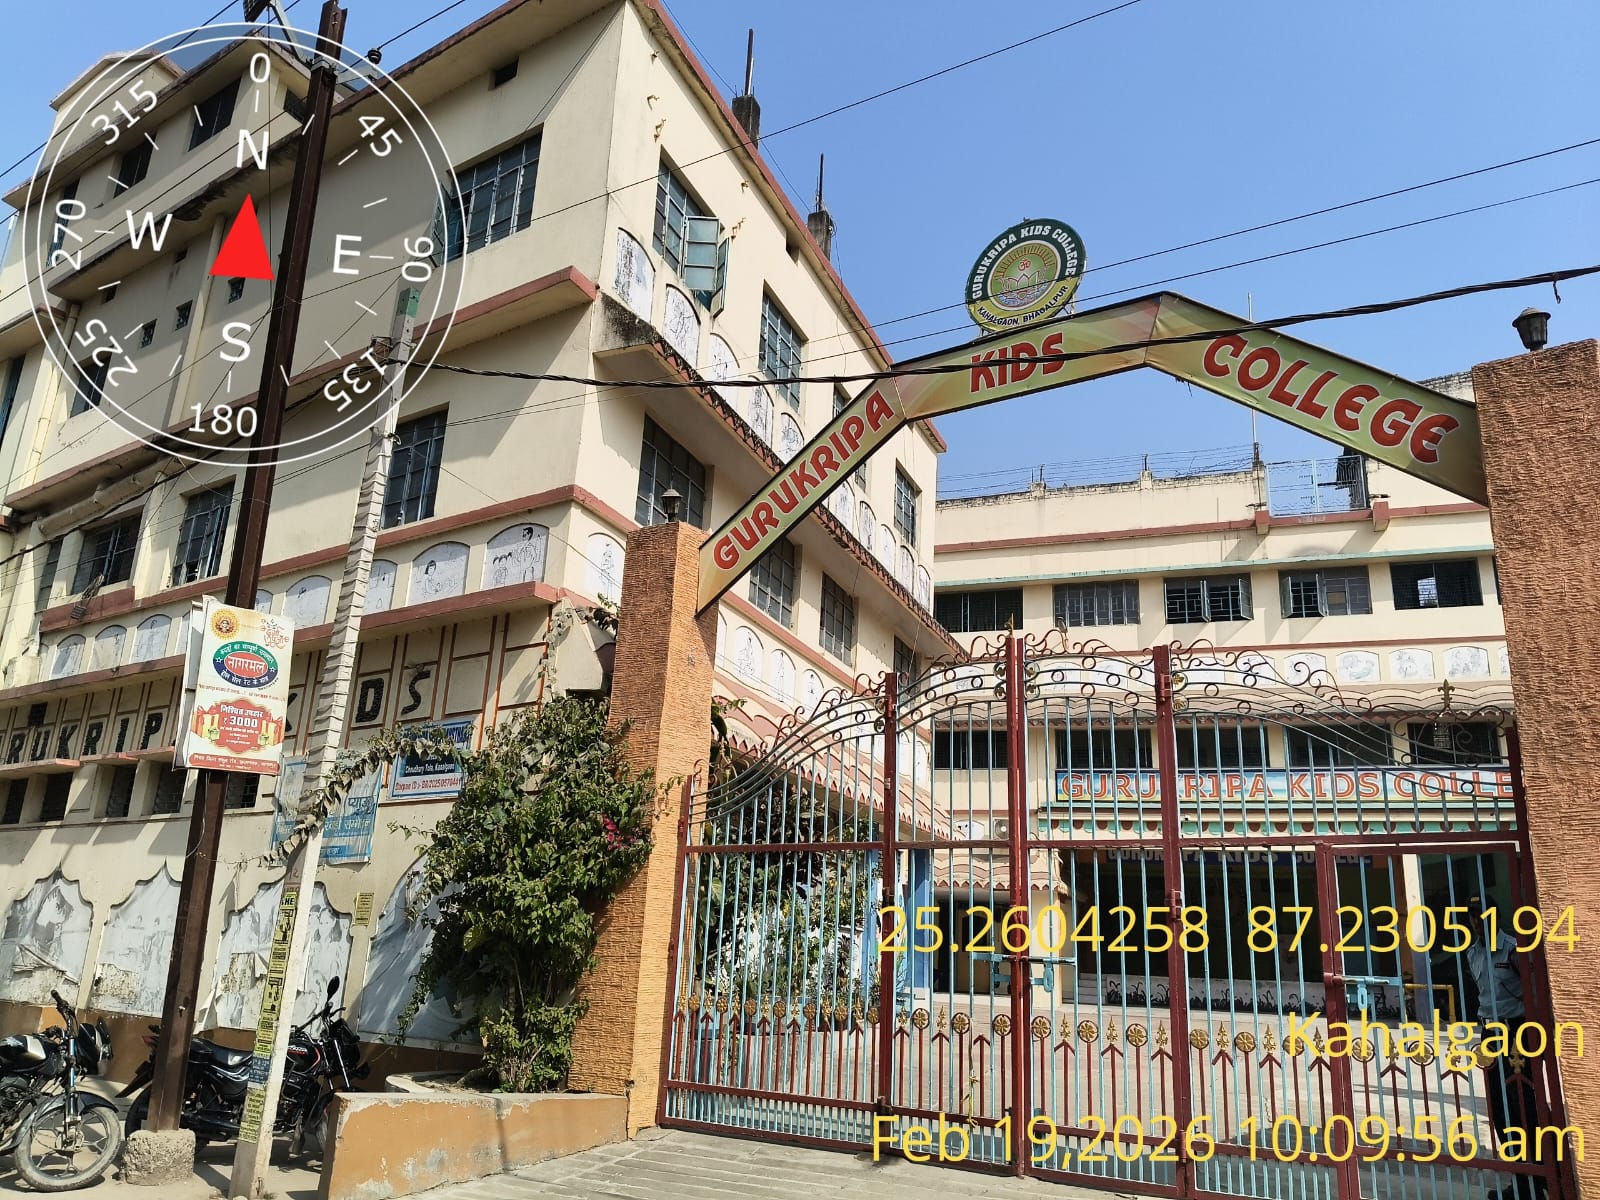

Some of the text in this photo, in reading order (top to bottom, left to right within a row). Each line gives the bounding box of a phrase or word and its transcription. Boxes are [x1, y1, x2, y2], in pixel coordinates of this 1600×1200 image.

[972, 225, 1078, 300] GURUKRIPA KIDS COLLEGE
[713, 332, 1460, 571] GURUKRIPA KIDS COLLEGE
[227, 655, 266, 675] नागरमल
[229, 716, 259, 728] 3000
[285, 670, 431, 733] KDS
[1061, 771, 1514, 799] GURURIPA KIDS COLLE
